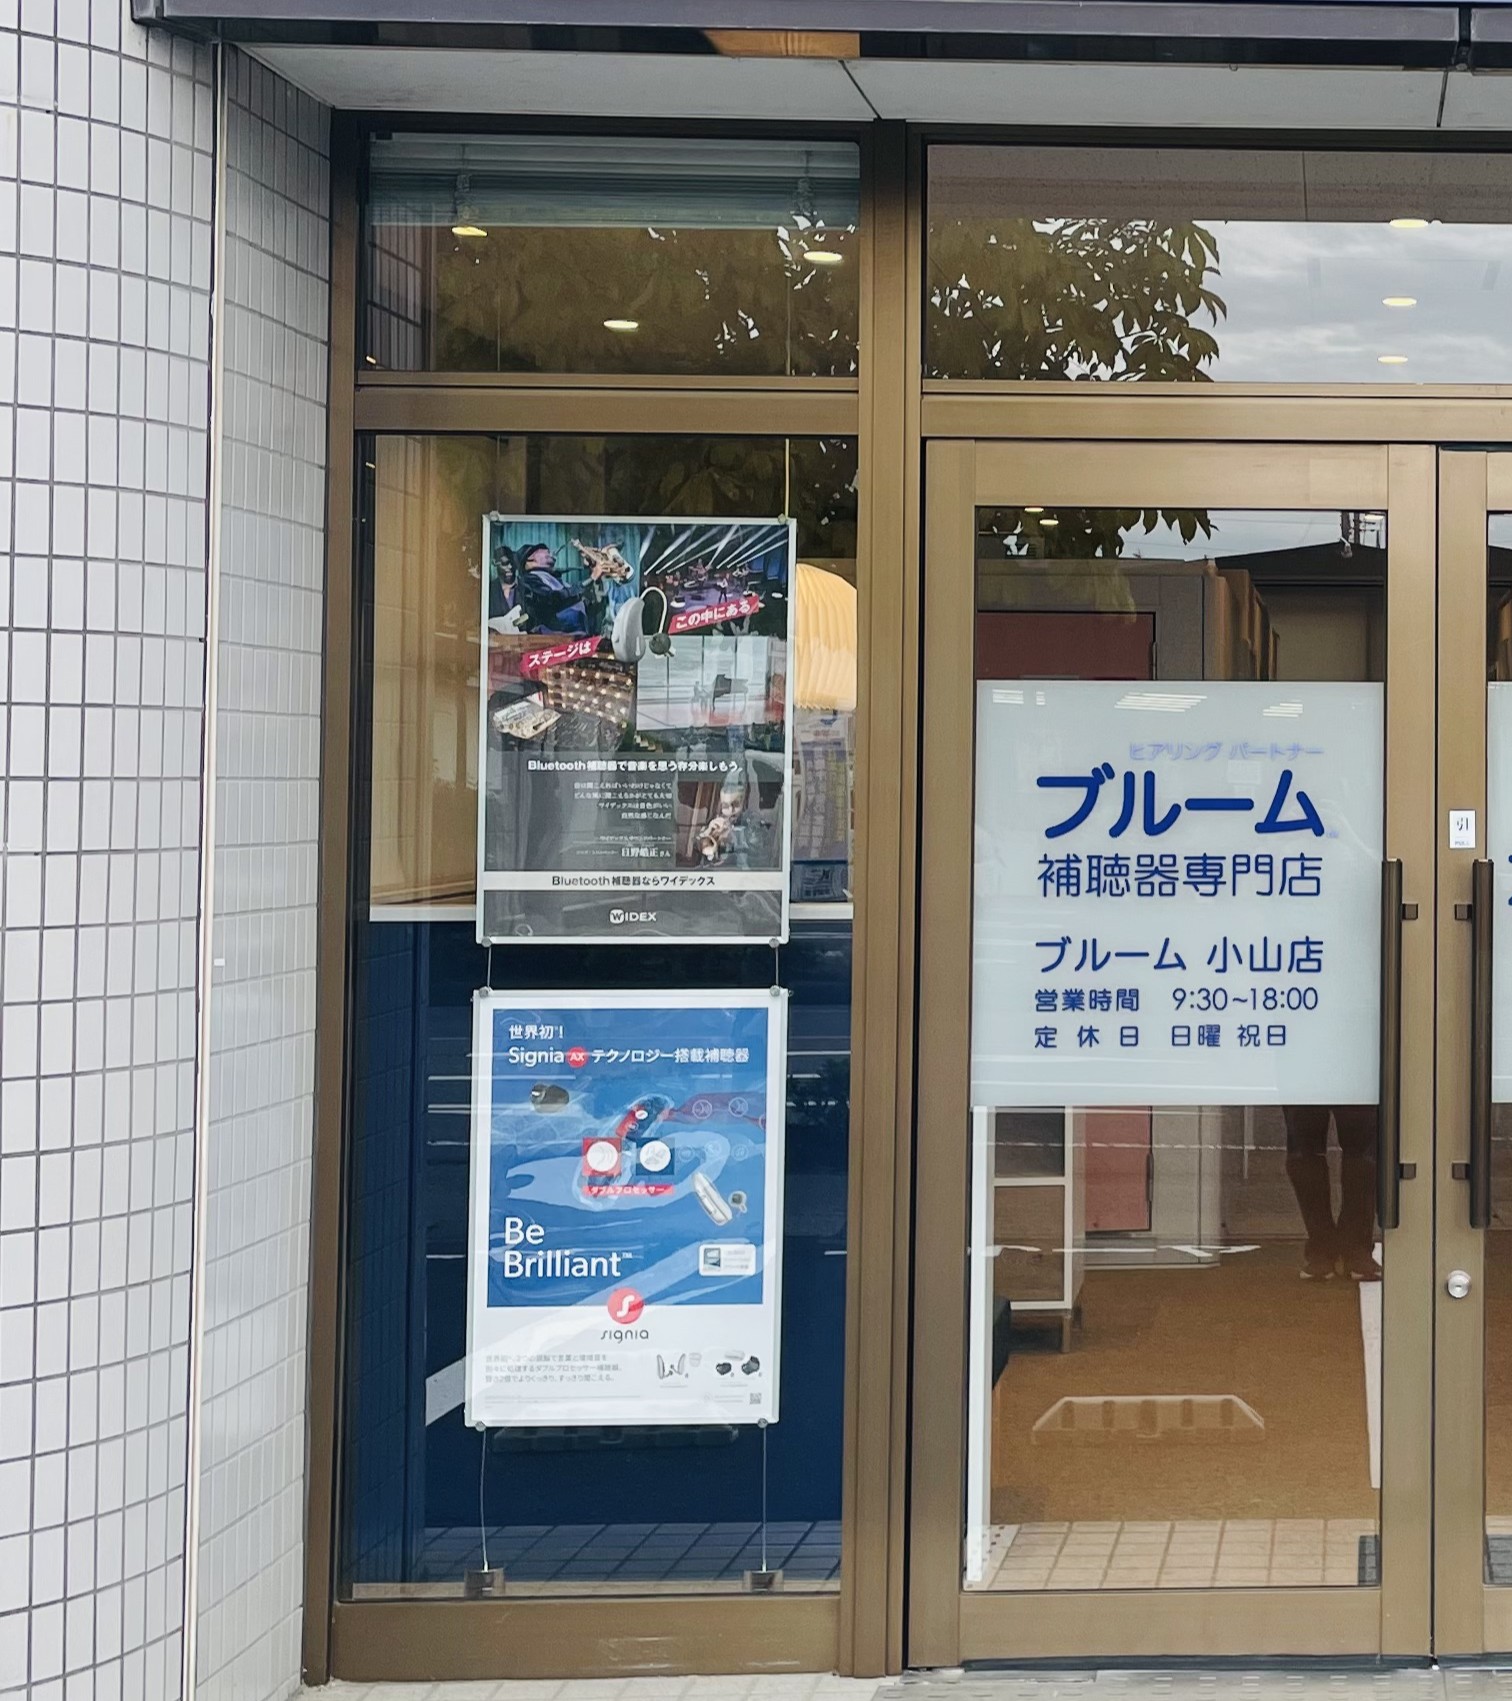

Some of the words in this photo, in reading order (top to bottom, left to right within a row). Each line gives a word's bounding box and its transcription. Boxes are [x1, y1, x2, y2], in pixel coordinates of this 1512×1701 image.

[676, 601, 751, 628] この中にある
[528, 640, 592, 668] ステージは
[1129, 742, 1222, 760] ヒアリング
[1229, 742, 1324, 760] パートナー
[1036, 762, 1325, 838] ブルーム
[1036, 852, 1324, 899] 補聴器専門店
[609, 908, 657, 924] WIDEX
[1035, 936, 1188, 974] ブルーム
[1206, 935, 1324, 974] 小山店
[1034, 987, 1140, 1013] 営業時間
[1171, 1024, 1222, 1048] 日曜
[1236, 1024, 1288, 1048] 祝日
[508, 1047, 565, 1068] Signia
[591, 1048, 750, 1064] テクノロジー搭載補聴器
[504, 1216, 545, 1246] Be
[600, 1328, 650, 1344] signia
